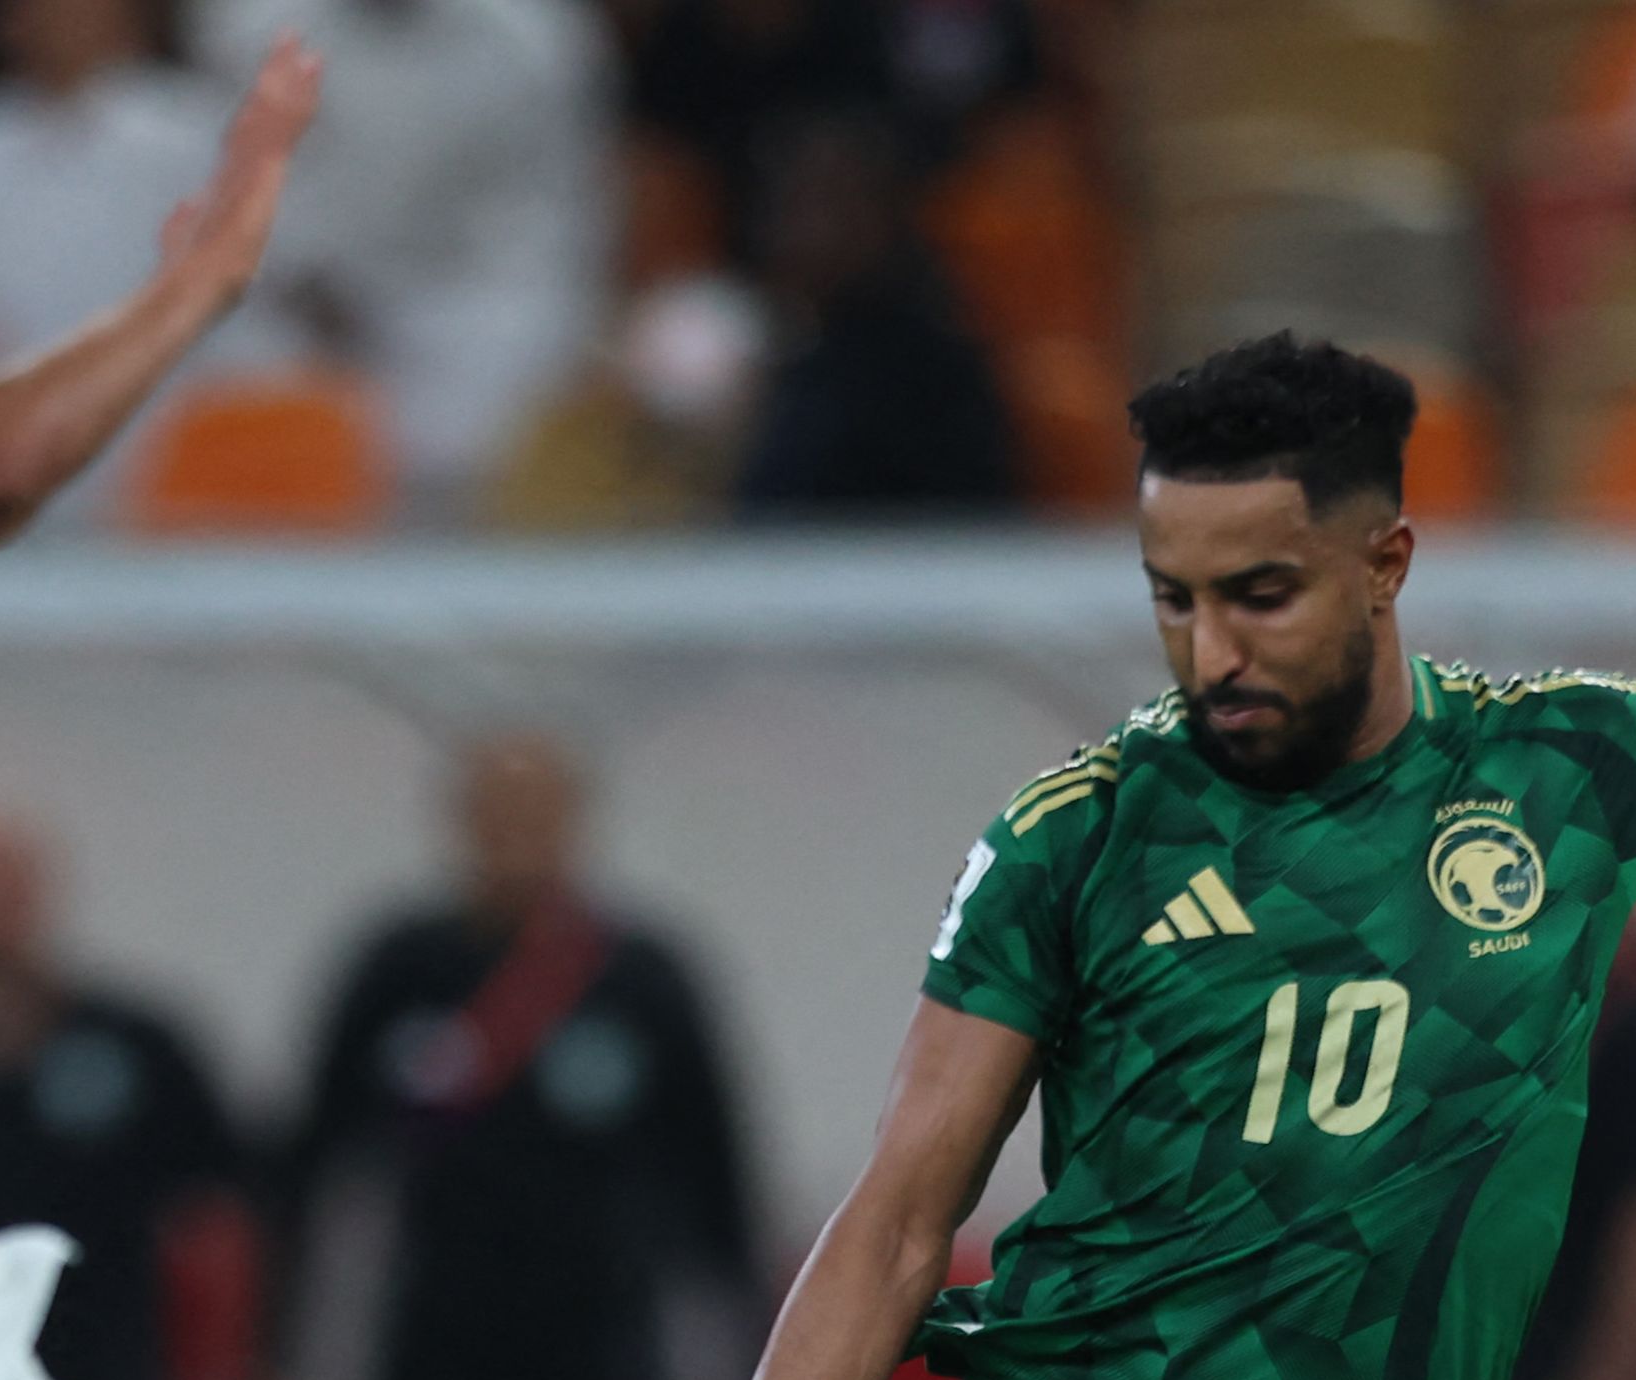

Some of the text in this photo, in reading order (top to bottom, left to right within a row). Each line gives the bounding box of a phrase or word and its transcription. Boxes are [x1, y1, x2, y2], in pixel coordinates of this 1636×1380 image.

[1495, 881, 1526, 896] SAFF
[1468, 932, 1532, 959] SAUDI
[1241, 979, 1409, 1145] 10
